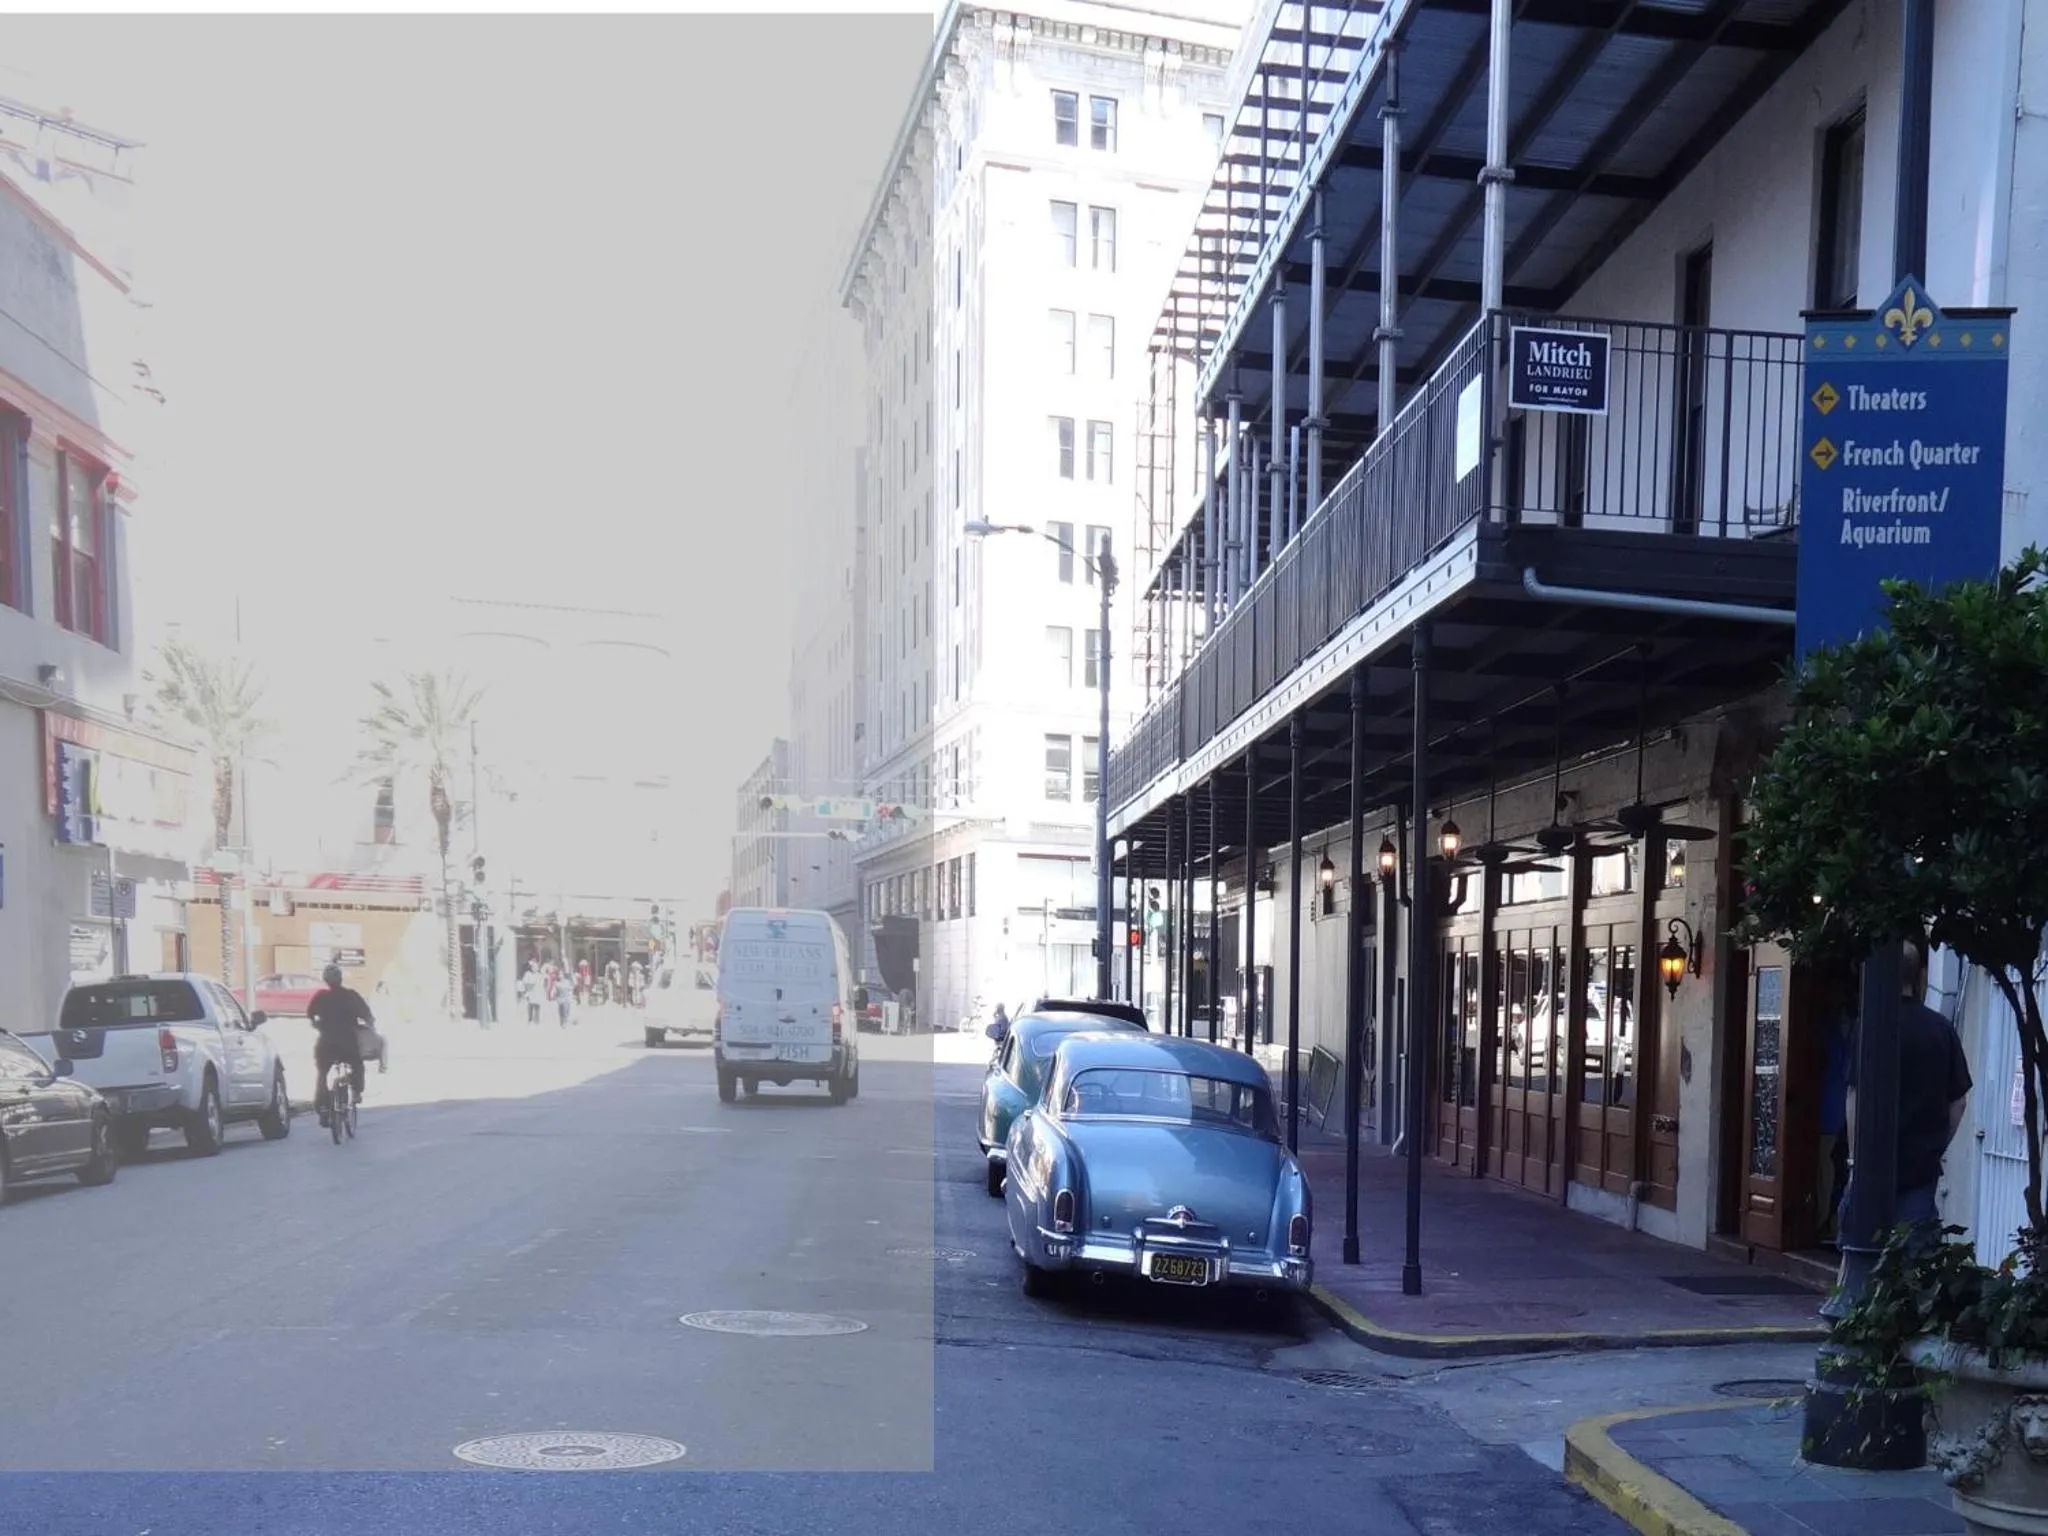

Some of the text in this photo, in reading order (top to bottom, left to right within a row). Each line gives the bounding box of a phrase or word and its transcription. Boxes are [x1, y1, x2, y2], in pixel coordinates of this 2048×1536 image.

[1529, 341, 1592, 367] Mitch
[1527, 364, 1593, 380] LANDRIEU
[1529, 383, 1588, 397] FOR MAYOR
[1848, 385, 1927, 411] Theaters
[1843, 439, 1980, 470] French Quarter
[1843, 487, 1950, 513] Riverfront/
[1840, 518, 1931, 549] Aquarium
[735, 946, 822, 959] NEW ORLEANS
[778, 1044, 810, 1060] FISH
